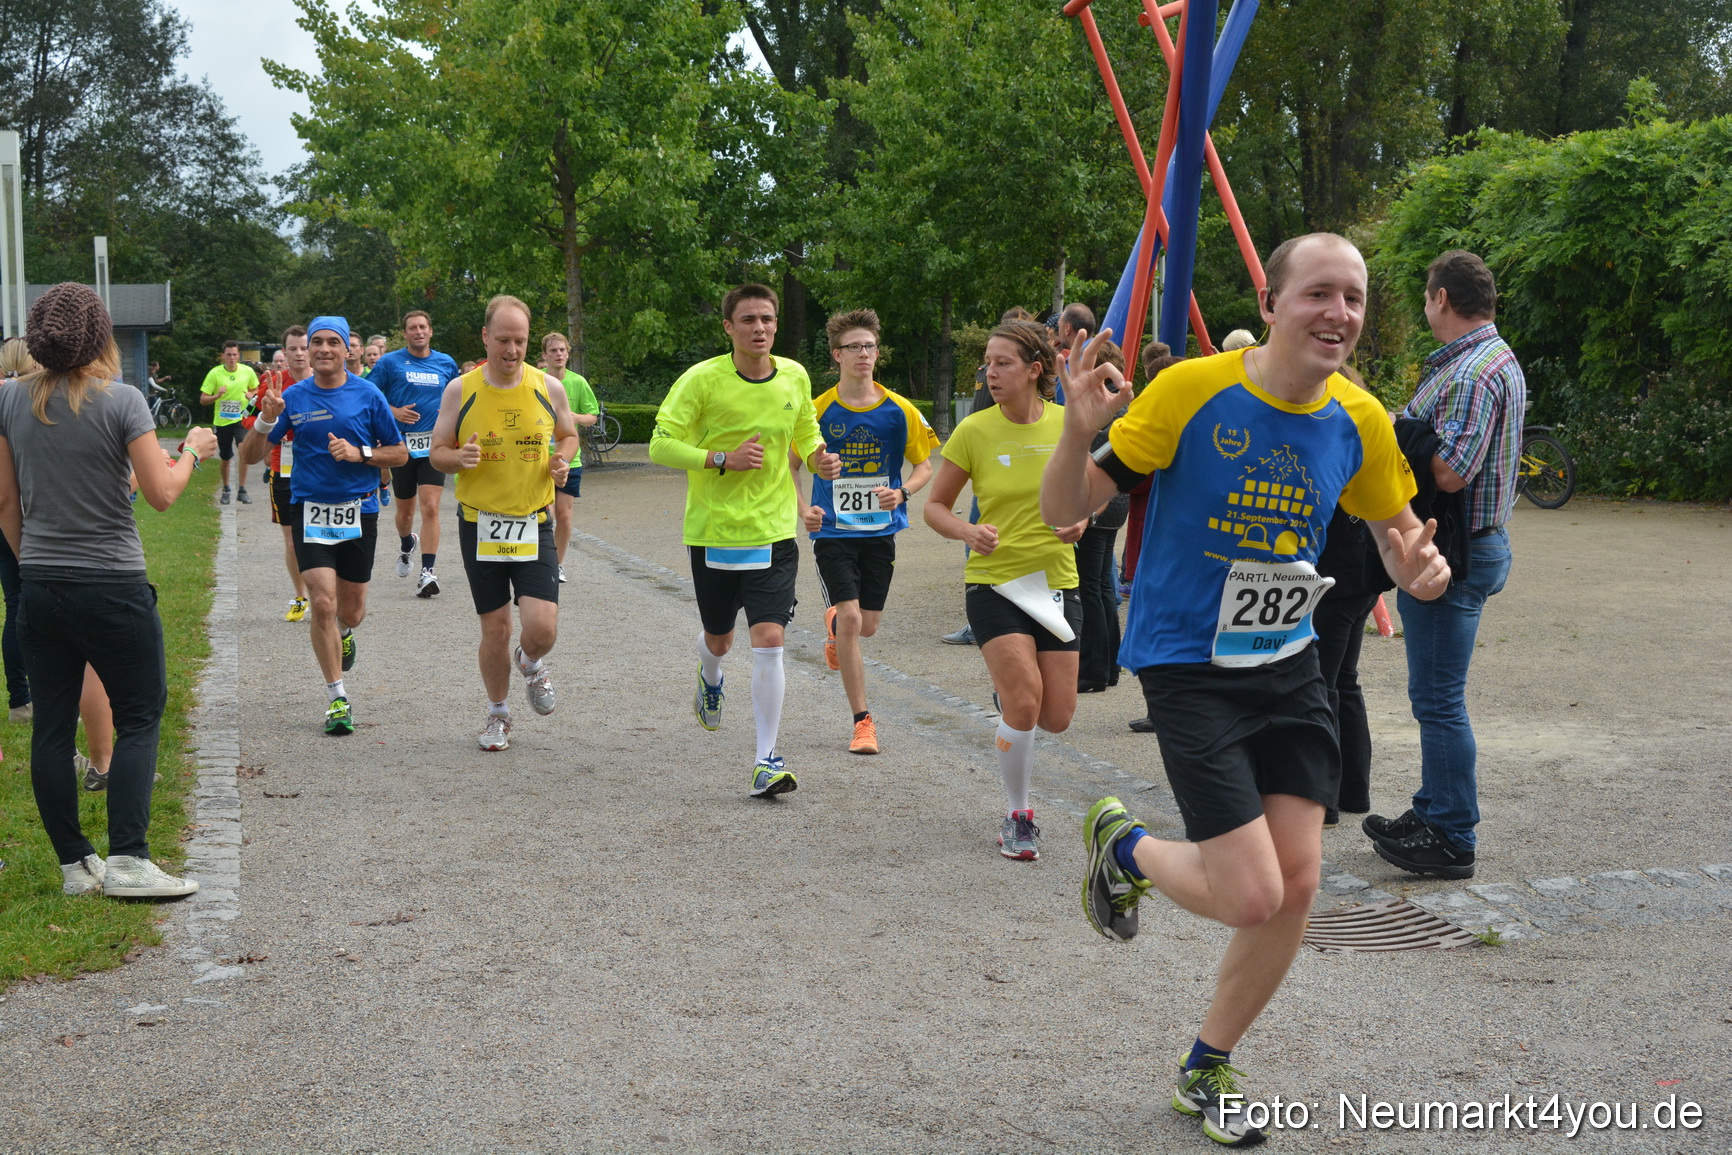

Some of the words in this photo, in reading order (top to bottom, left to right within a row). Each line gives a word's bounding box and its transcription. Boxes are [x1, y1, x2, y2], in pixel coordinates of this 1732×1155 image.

[406, 371, 439, 380] HUBER
[222, 404, 240, 413] 2225
[409, 436, 432, 450] 287
[1220, 437, 1242, 447] Jahre
[839, 490, 882, 512] 281
[310, 506, 355, 526] 2159
[1226, 510, 1288, 525] 21.September
[1289, 518, 1308, 528] 2014
[320, 529, 346, 538] Robert
[490, 519, 527, 541] 277
[496, 545, 518, 554] Jockl
[1229, 571, 1270, 583] PARTL
[1252, 635, 1288, 650] Davi
